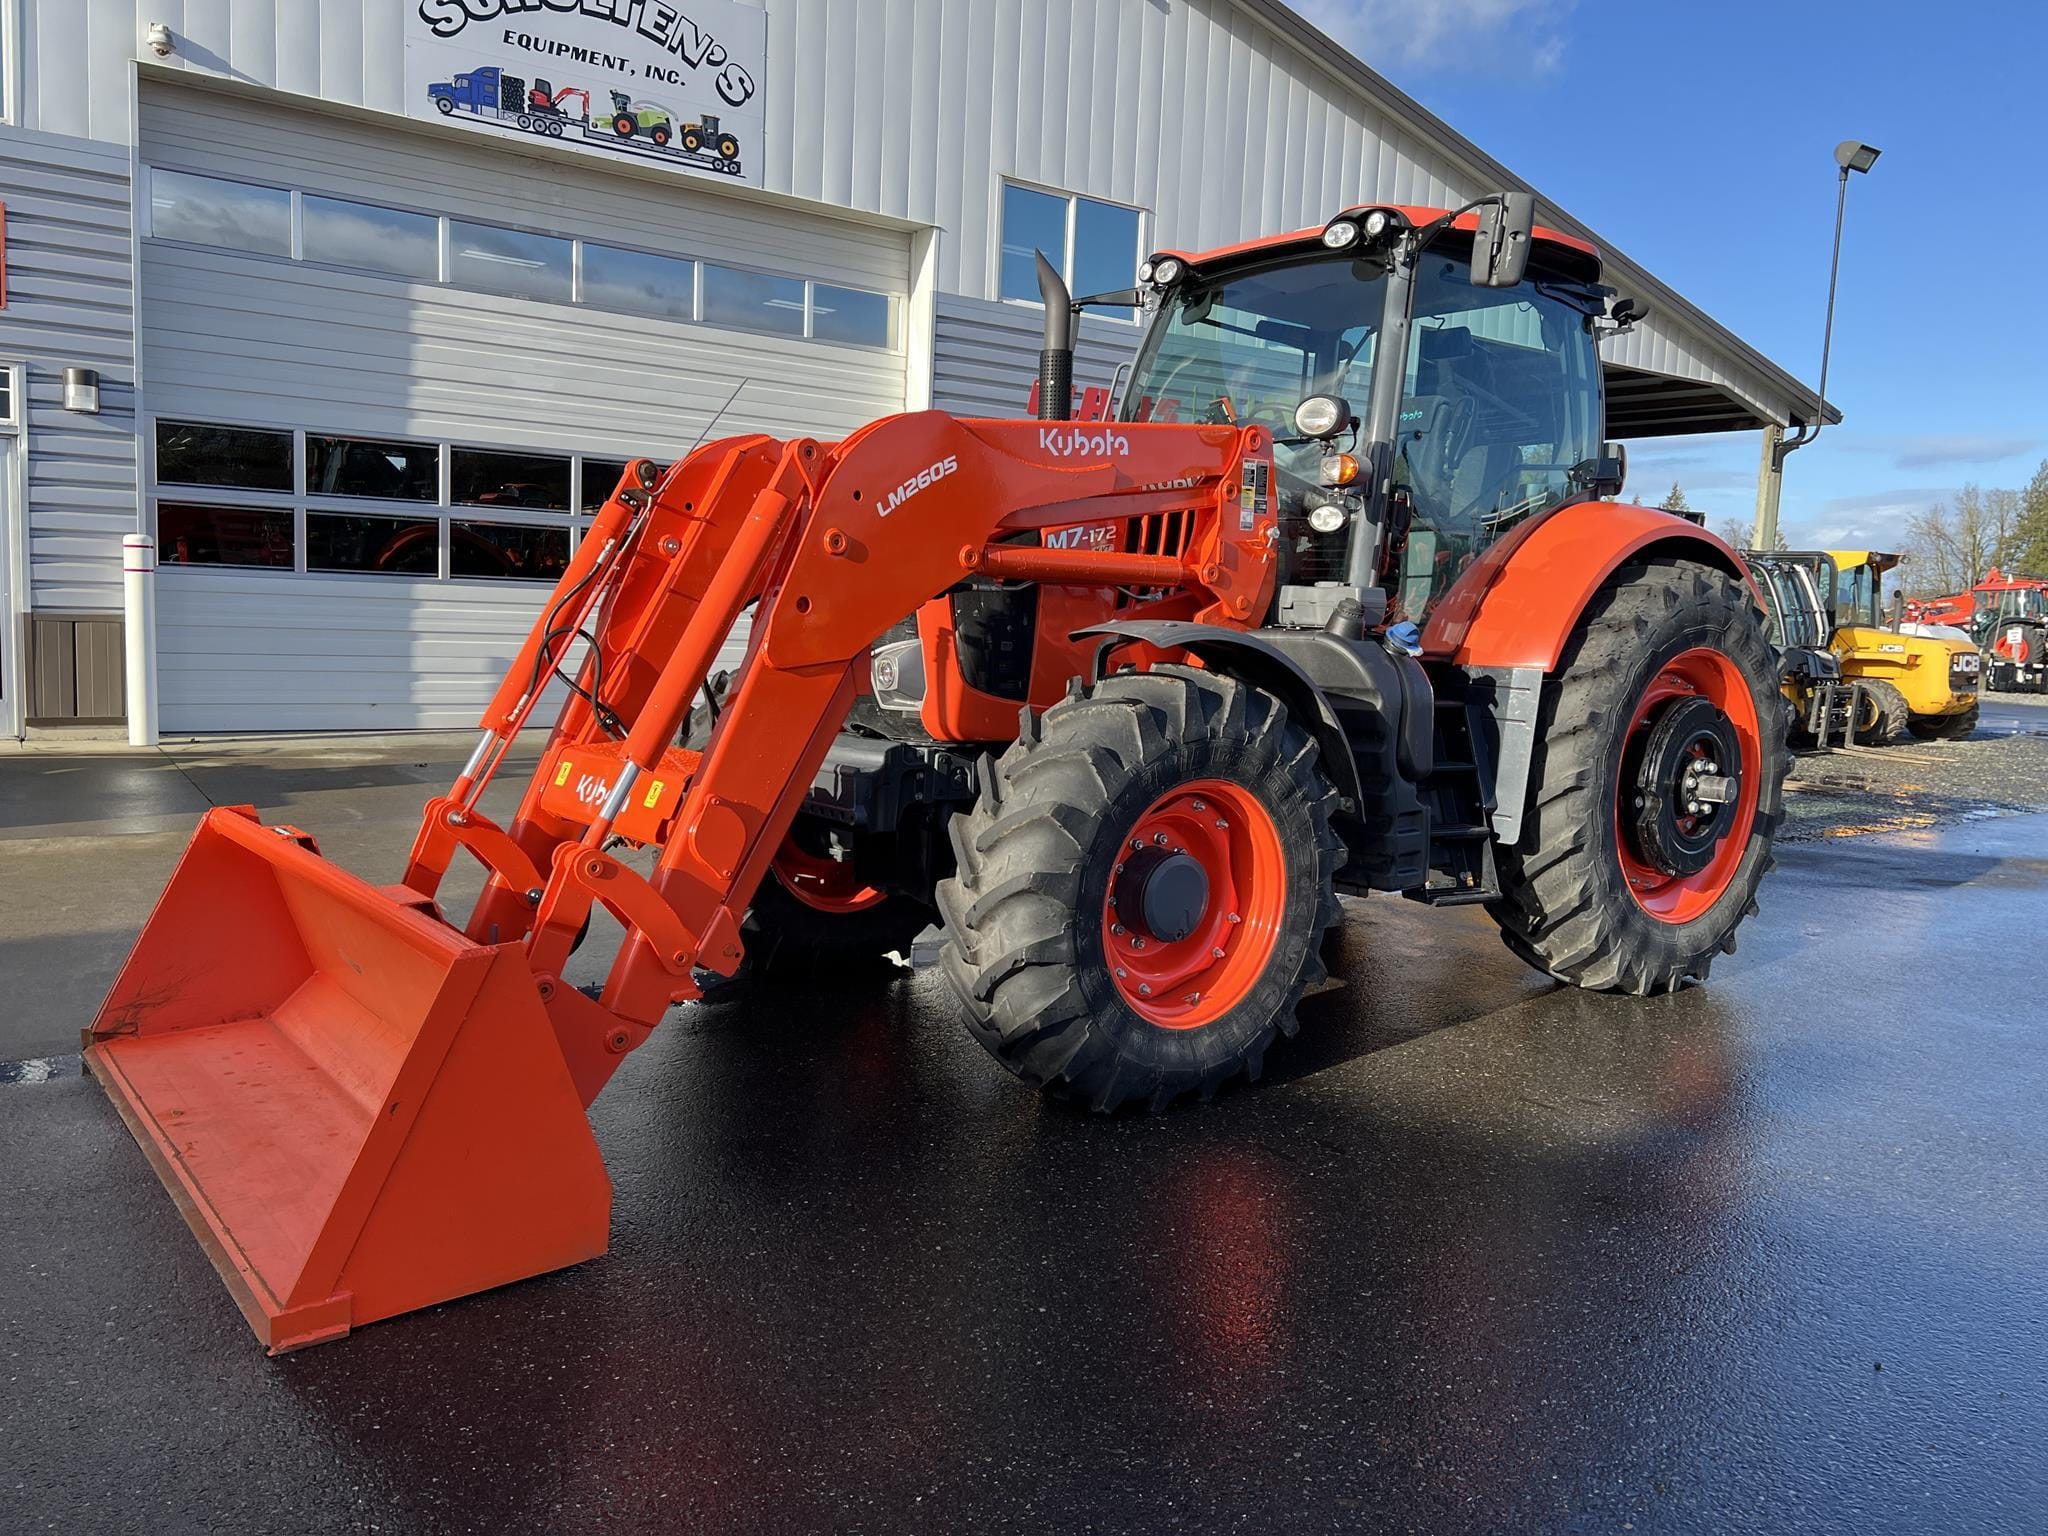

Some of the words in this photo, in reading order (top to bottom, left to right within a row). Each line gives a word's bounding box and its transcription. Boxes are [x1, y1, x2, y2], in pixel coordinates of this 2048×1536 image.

[503, 29, 636, 77] EQUIPMENT,
[645, 64, 686, 87] INC.
[1039, 428, 1129, 456] Kubota
[876, 454, 958, 518] LM2605
[1047, 526, 1117, 549] M7-172
[1877, 643, 1905, 653] JCB
[1953, 655, 1980, 673] JCB
